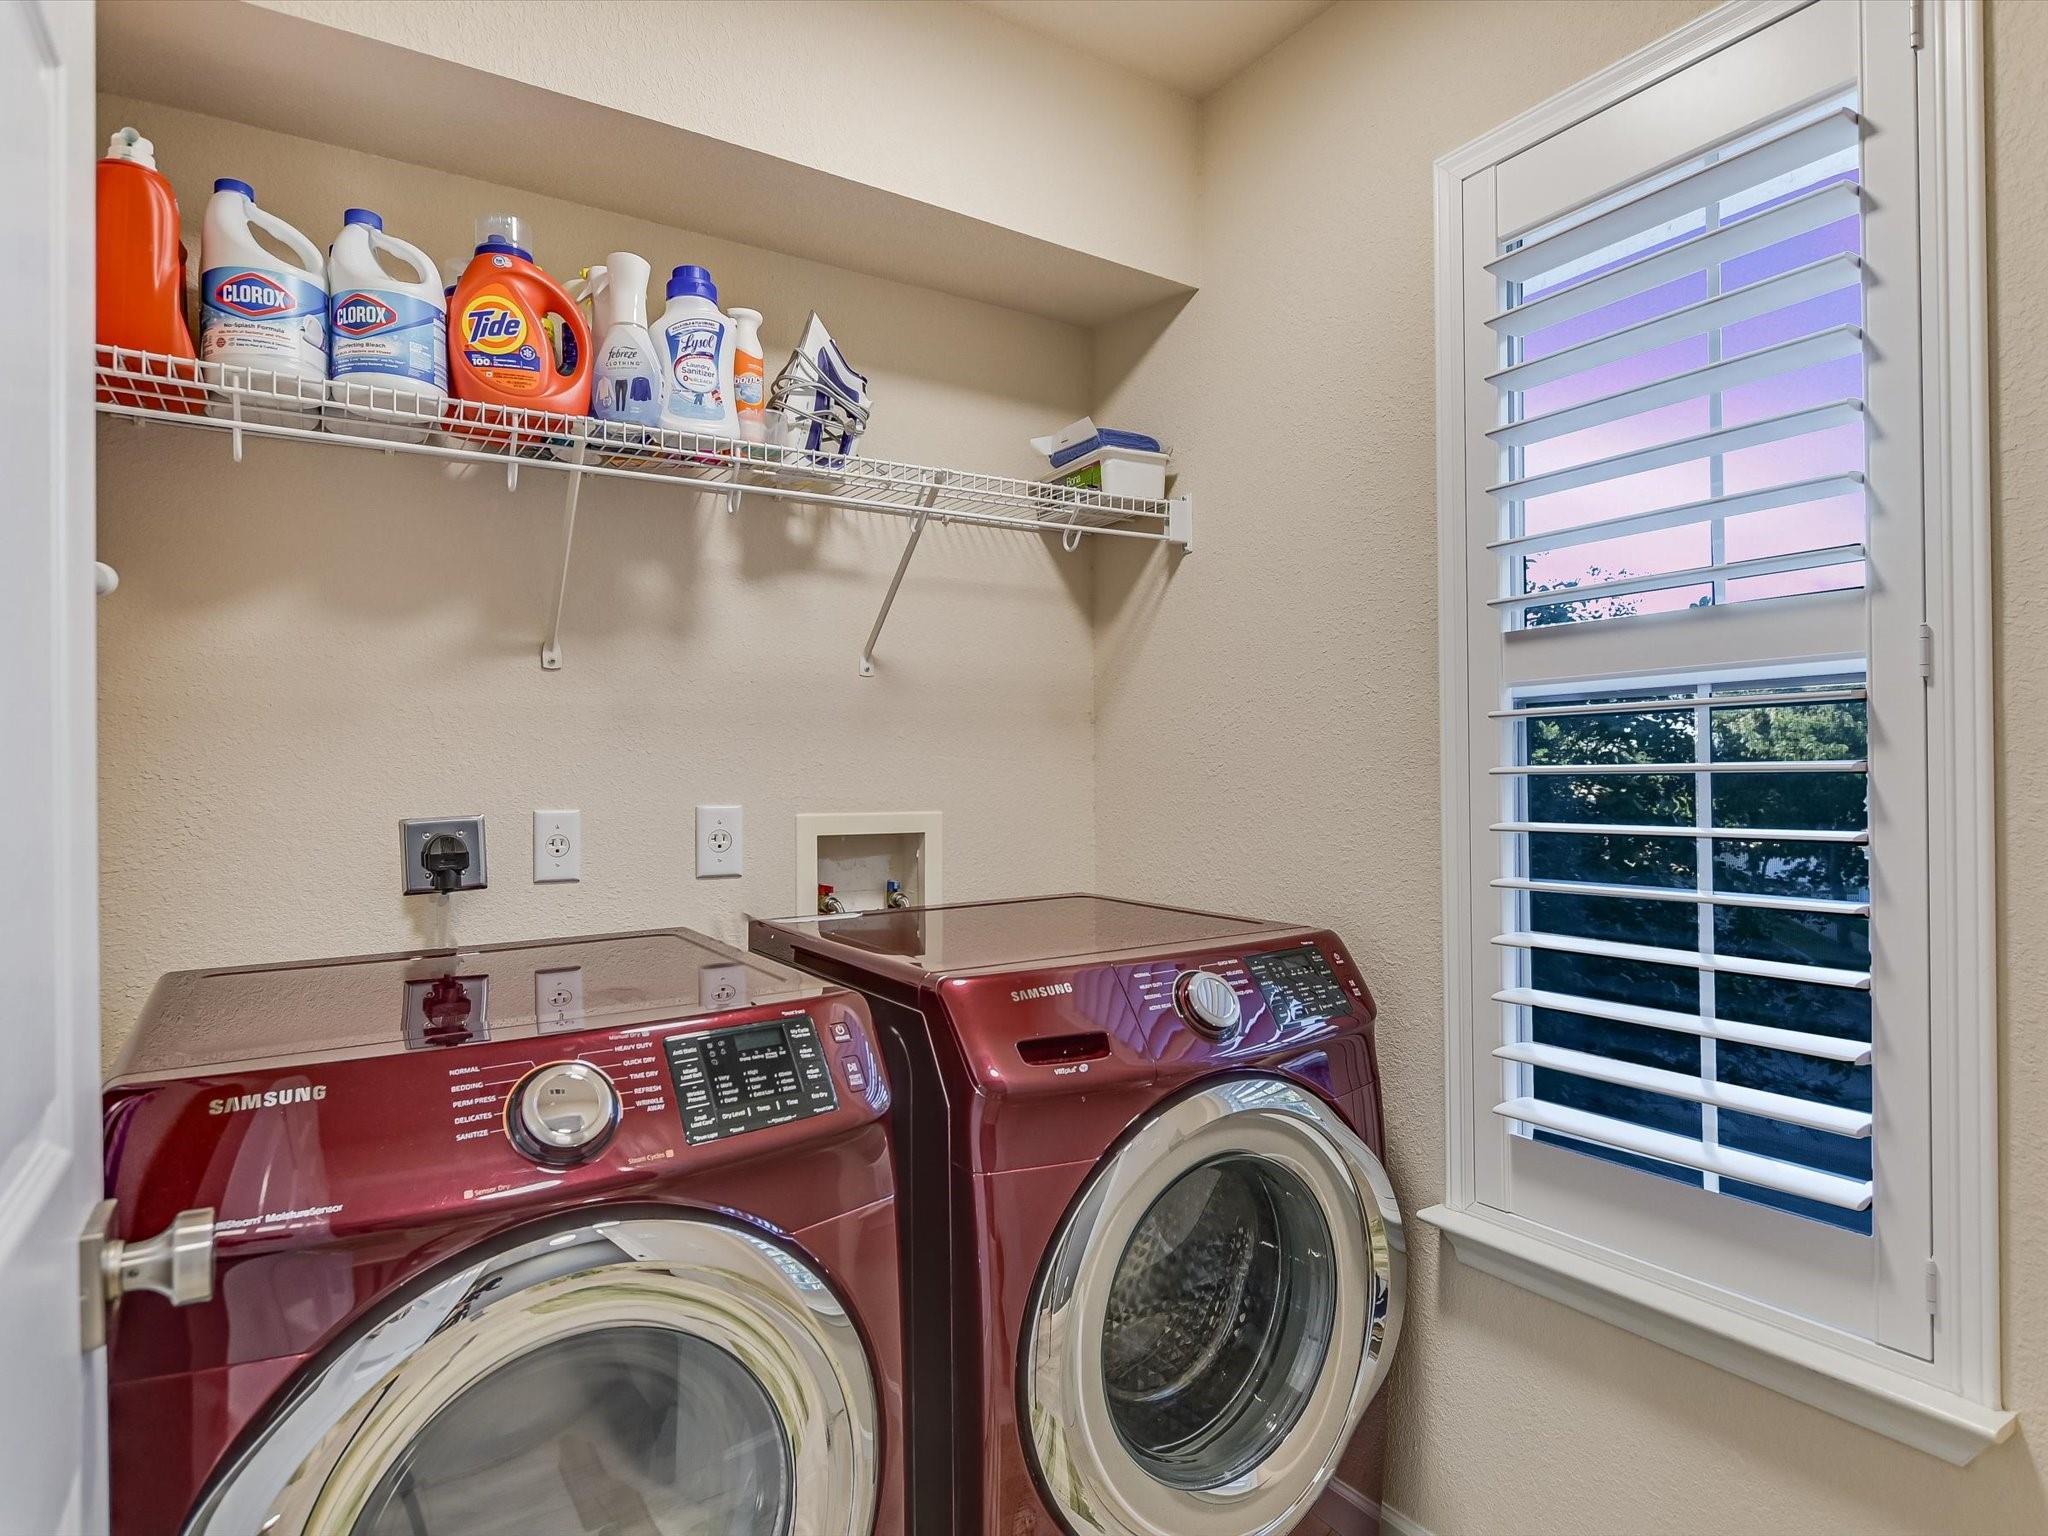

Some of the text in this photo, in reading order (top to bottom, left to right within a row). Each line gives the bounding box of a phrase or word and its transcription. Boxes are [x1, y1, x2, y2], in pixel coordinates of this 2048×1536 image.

[222, 284, 286, 309] CLOROX
[336, 306, 387, 326] CLOROX
[257, 323, 285, 334] Formula
[468, 310, 521, 343] Tide
[681, 334, 715, 353] Lysol
[607, 346, 638, 361] febreze
[472, 358, 491, 366] 100
[686, 362, 710, 371] Laundry
[681, 367, 715, 378] Sanitizer
[1010, 982, 1073, 1002] SAMSUNG
[614, 1042, 653, 1052] HEAVY DUTY
[623, 1056, 656, 1067] QUICK DRY
[448, 1066, 481, 1077] NORMAL
[629, 1070, 659, 1080] TIME DRY
[450, 1082, 484, 1093] BEDDING
[633, 1085, 662, 1094] REFRESH
[208, 1085, 327, 1115] SAMSUNG
[452, 1095, 497, 1109] PERM PRESS
[635, 1097, 664, 1106] WRINKLE
[647, 1104, 665, 1112] AWAY
[454, 1112, 493, 1125] DELICATES
[455, 1129, 489, 1142] SANITIZE
[628, 1152, 666, 1164] Steam Cycles
[474, 1184, 511, 1197] Sensor Dry
